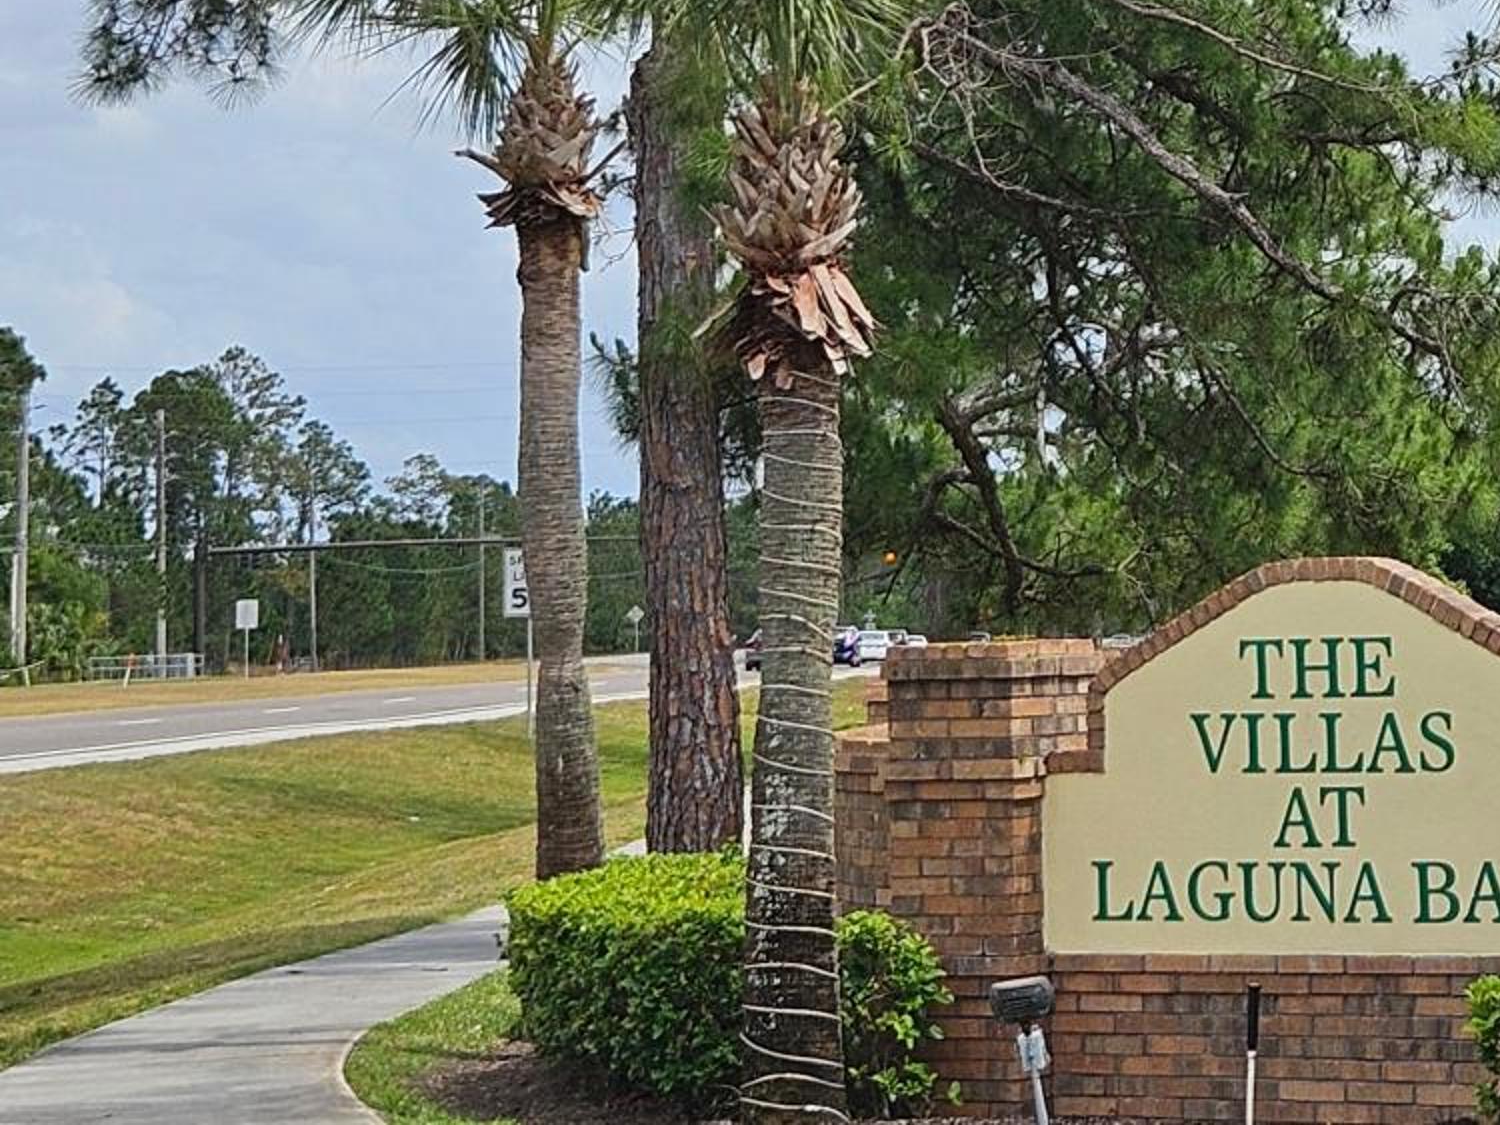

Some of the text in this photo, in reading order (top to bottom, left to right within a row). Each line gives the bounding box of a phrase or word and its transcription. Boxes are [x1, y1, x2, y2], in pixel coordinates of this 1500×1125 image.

[511, 587, 528, 609] 5
[1239, 636, 1395, 700] THE
[1190, 711, 1455, 774] VILLAS
[1273, 786, 1365, 848] AT
[1091, 860, 1393, 924] LAGUNA
